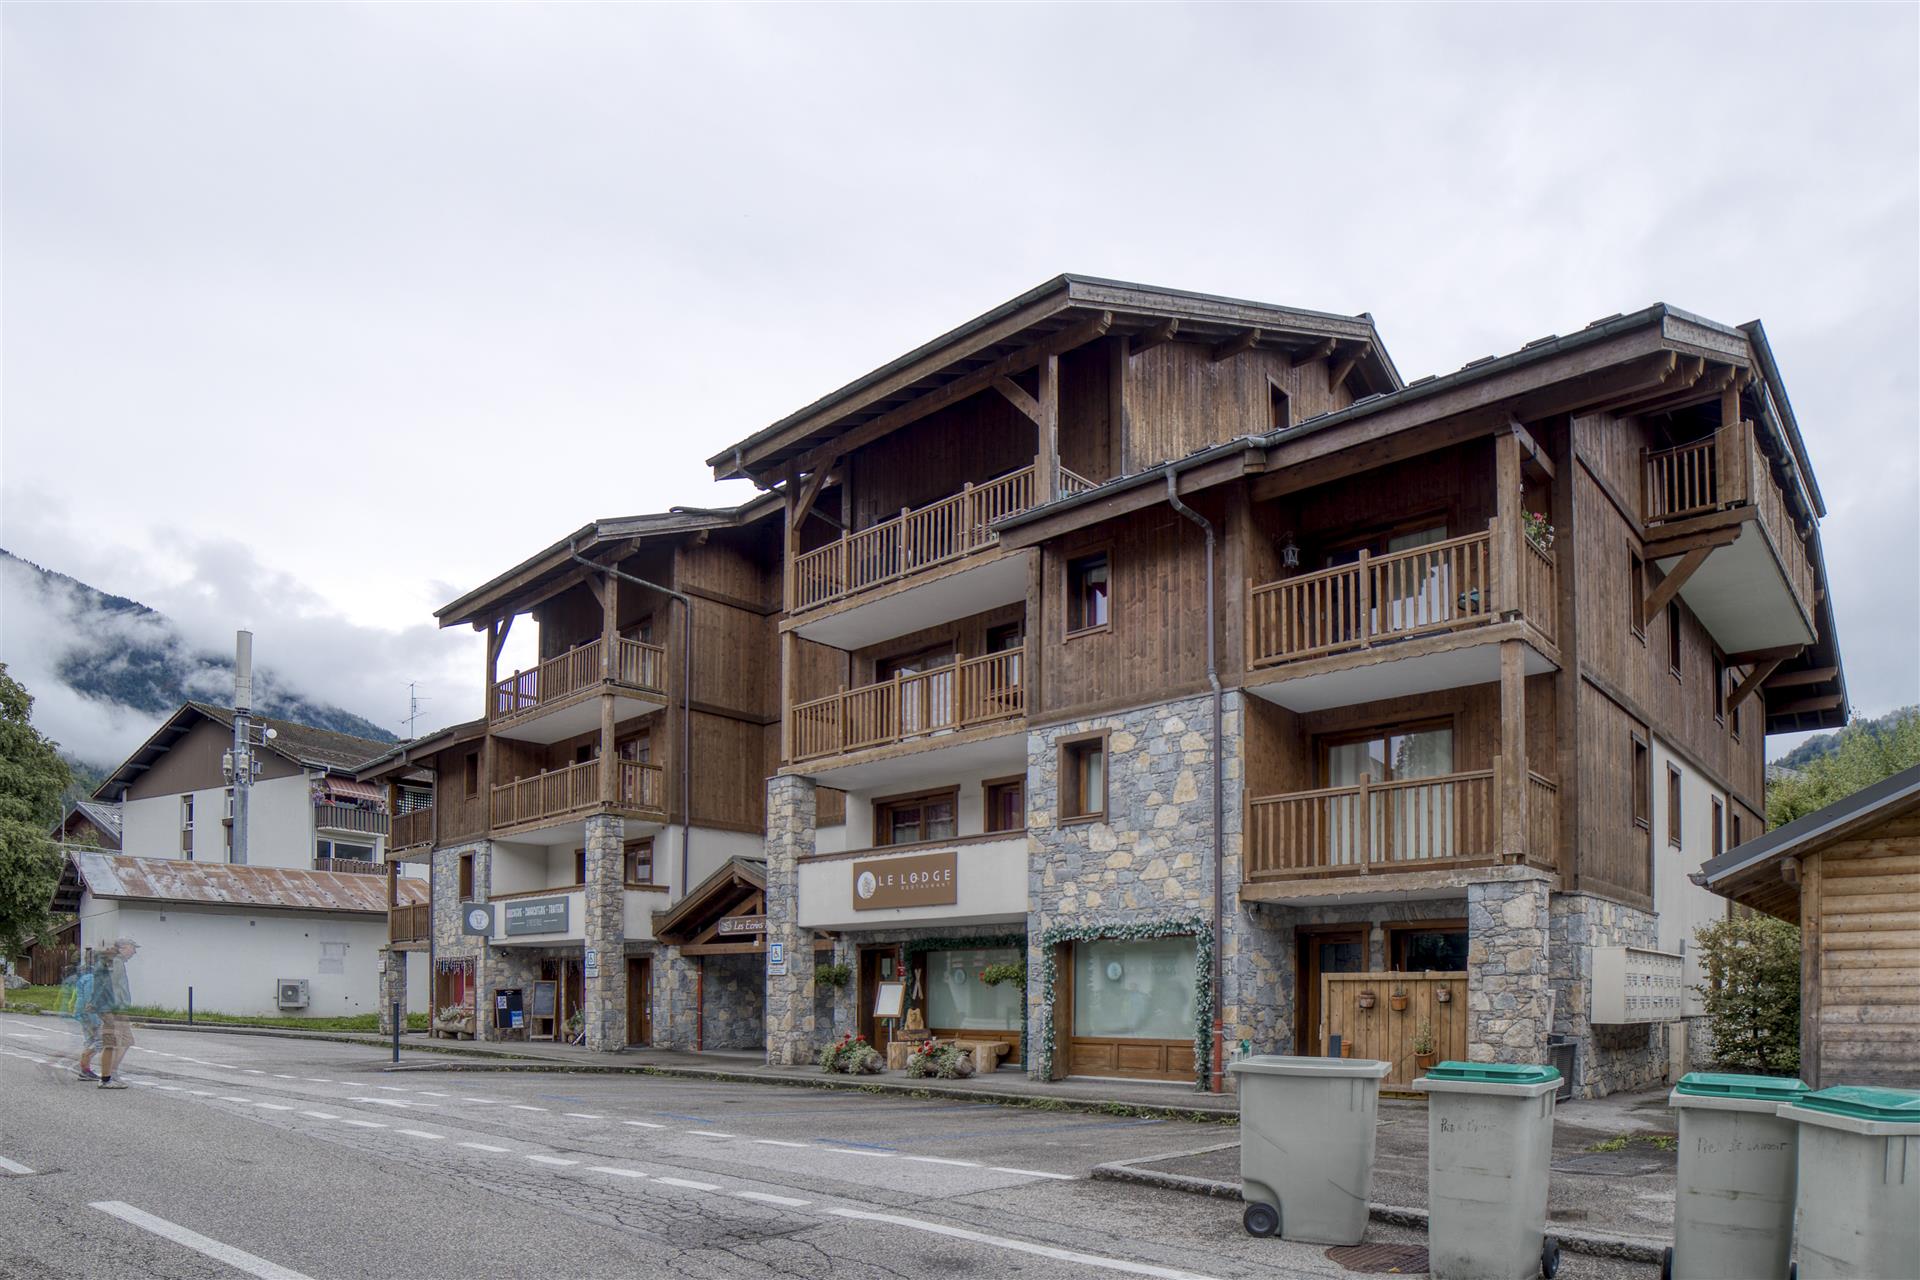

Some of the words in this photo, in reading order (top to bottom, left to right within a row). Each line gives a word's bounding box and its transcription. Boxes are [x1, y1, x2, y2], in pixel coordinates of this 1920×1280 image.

[878, 874, 894, 886] LE
[900, 869, 951, 885] LODGE
[900, 881, 951, 891] RESTAURANT
